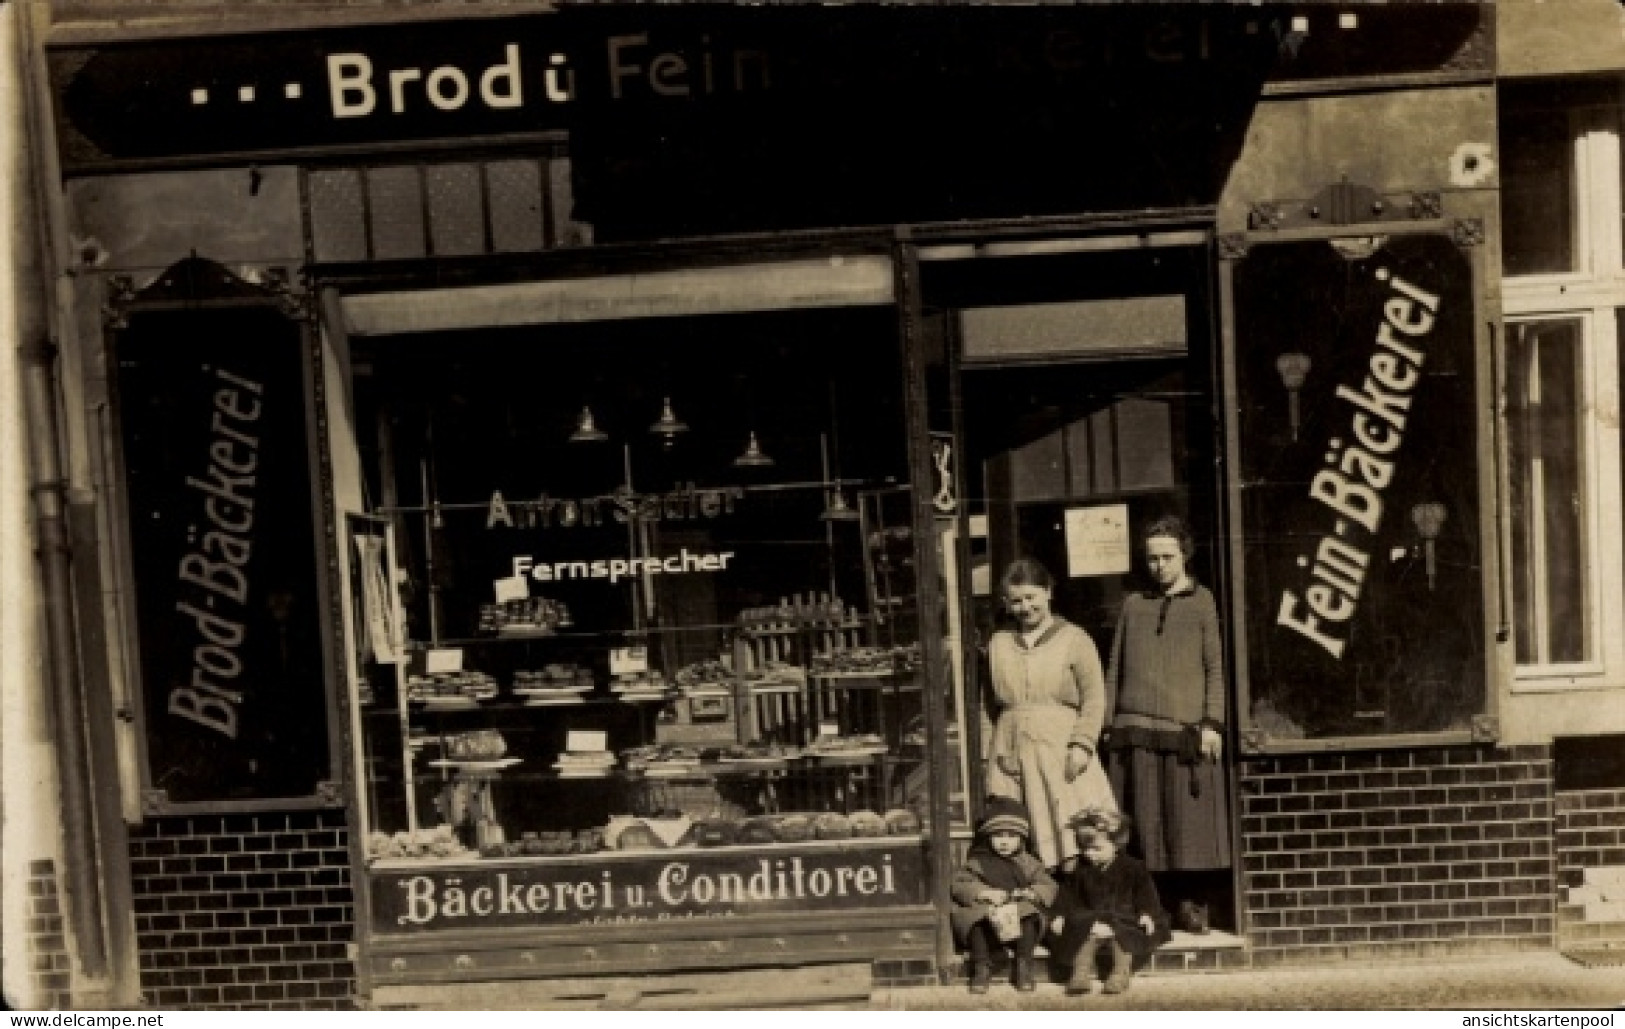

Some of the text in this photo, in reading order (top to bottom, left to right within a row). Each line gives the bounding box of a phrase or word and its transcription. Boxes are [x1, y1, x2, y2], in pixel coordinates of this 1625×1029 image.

[326, 44, 524, 118] Brod
[1277, 265, 1441, 659] Fein-Bäckerei
[168, 363, 264, 739] Brod-Bäckerei
[512, 548, 735, 585] Fernsprecher
[397, 853, 897, 926] Bäckerei u. Conditorei
